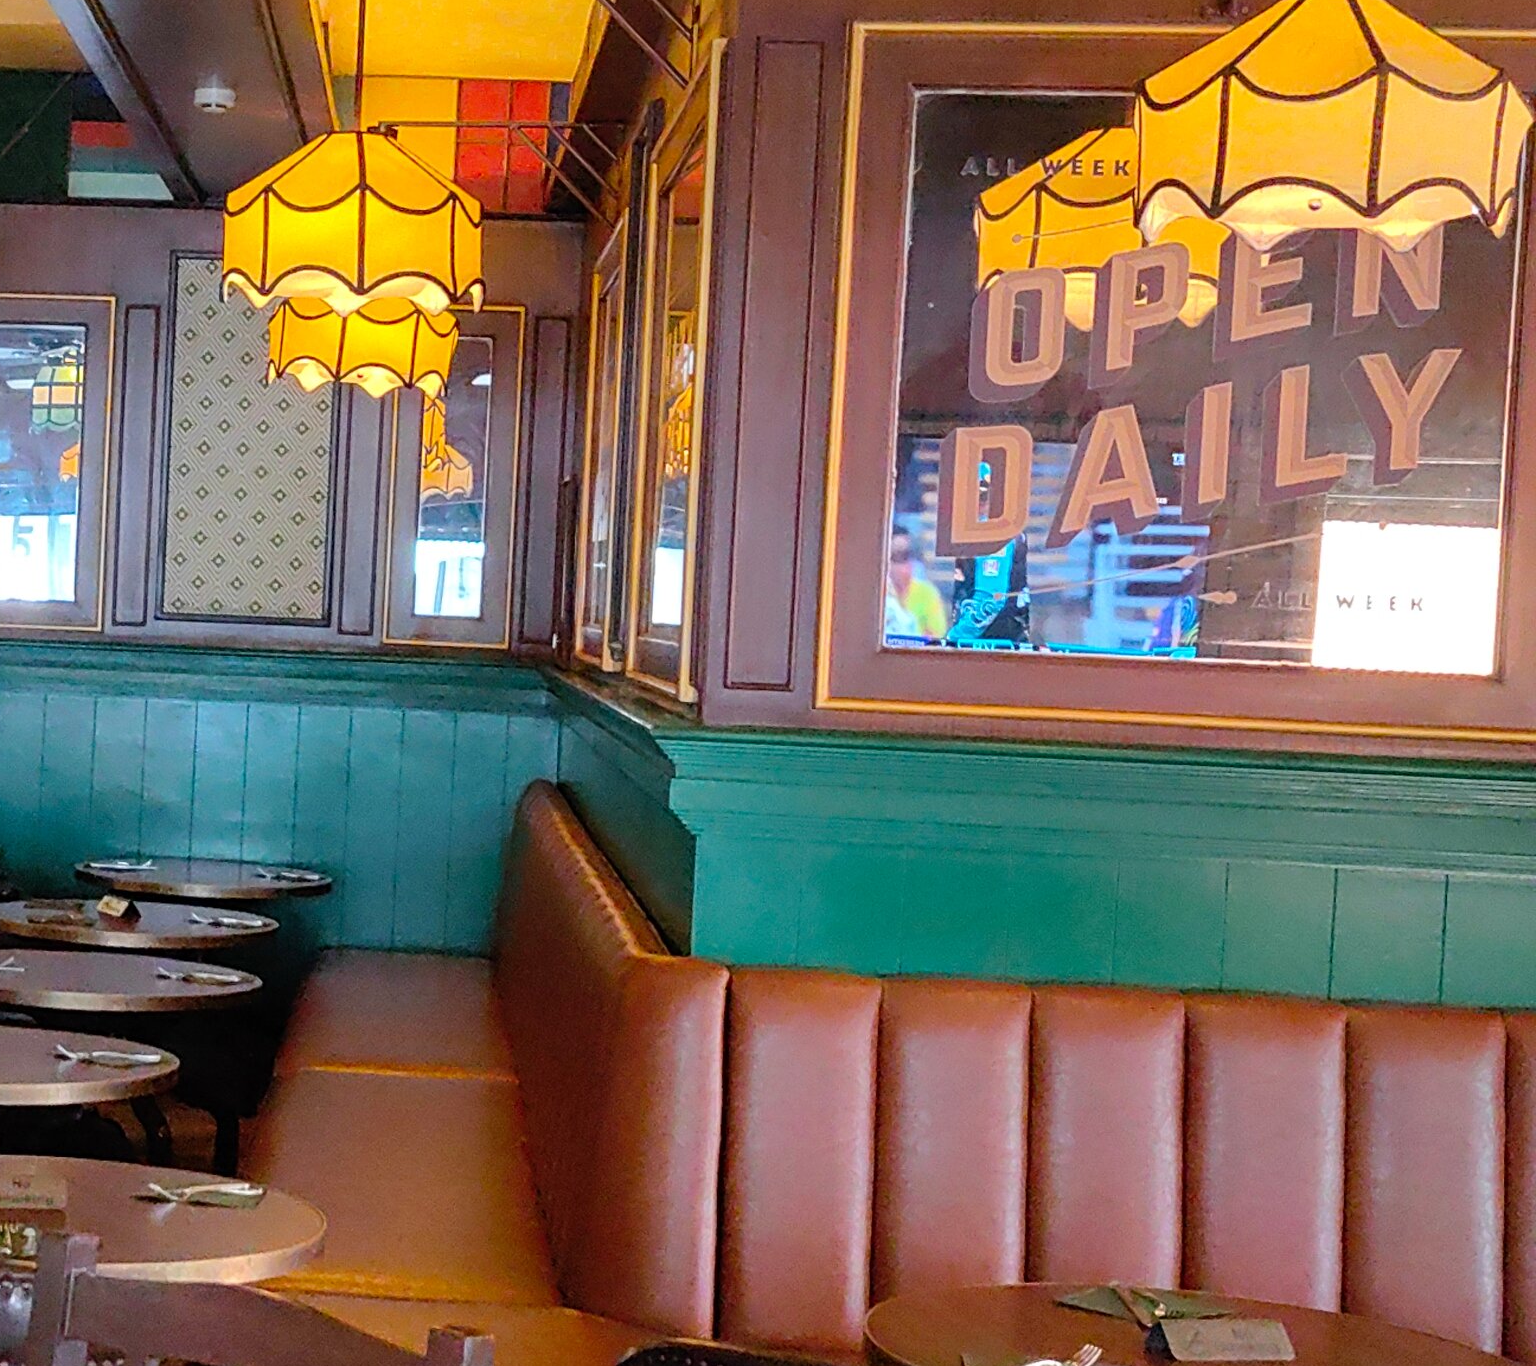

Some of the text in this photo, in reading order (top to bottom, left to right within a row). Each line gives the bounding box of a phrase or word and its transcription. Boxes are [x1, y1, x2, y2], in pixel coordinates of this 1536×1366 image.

[960, 156, 1130, 177] ALL WEEK
[968, 228, 1443, 402] OPEN
[936, 348, 1463, 557] DAILY
[1336, 594, 1424, 612] WEEK
